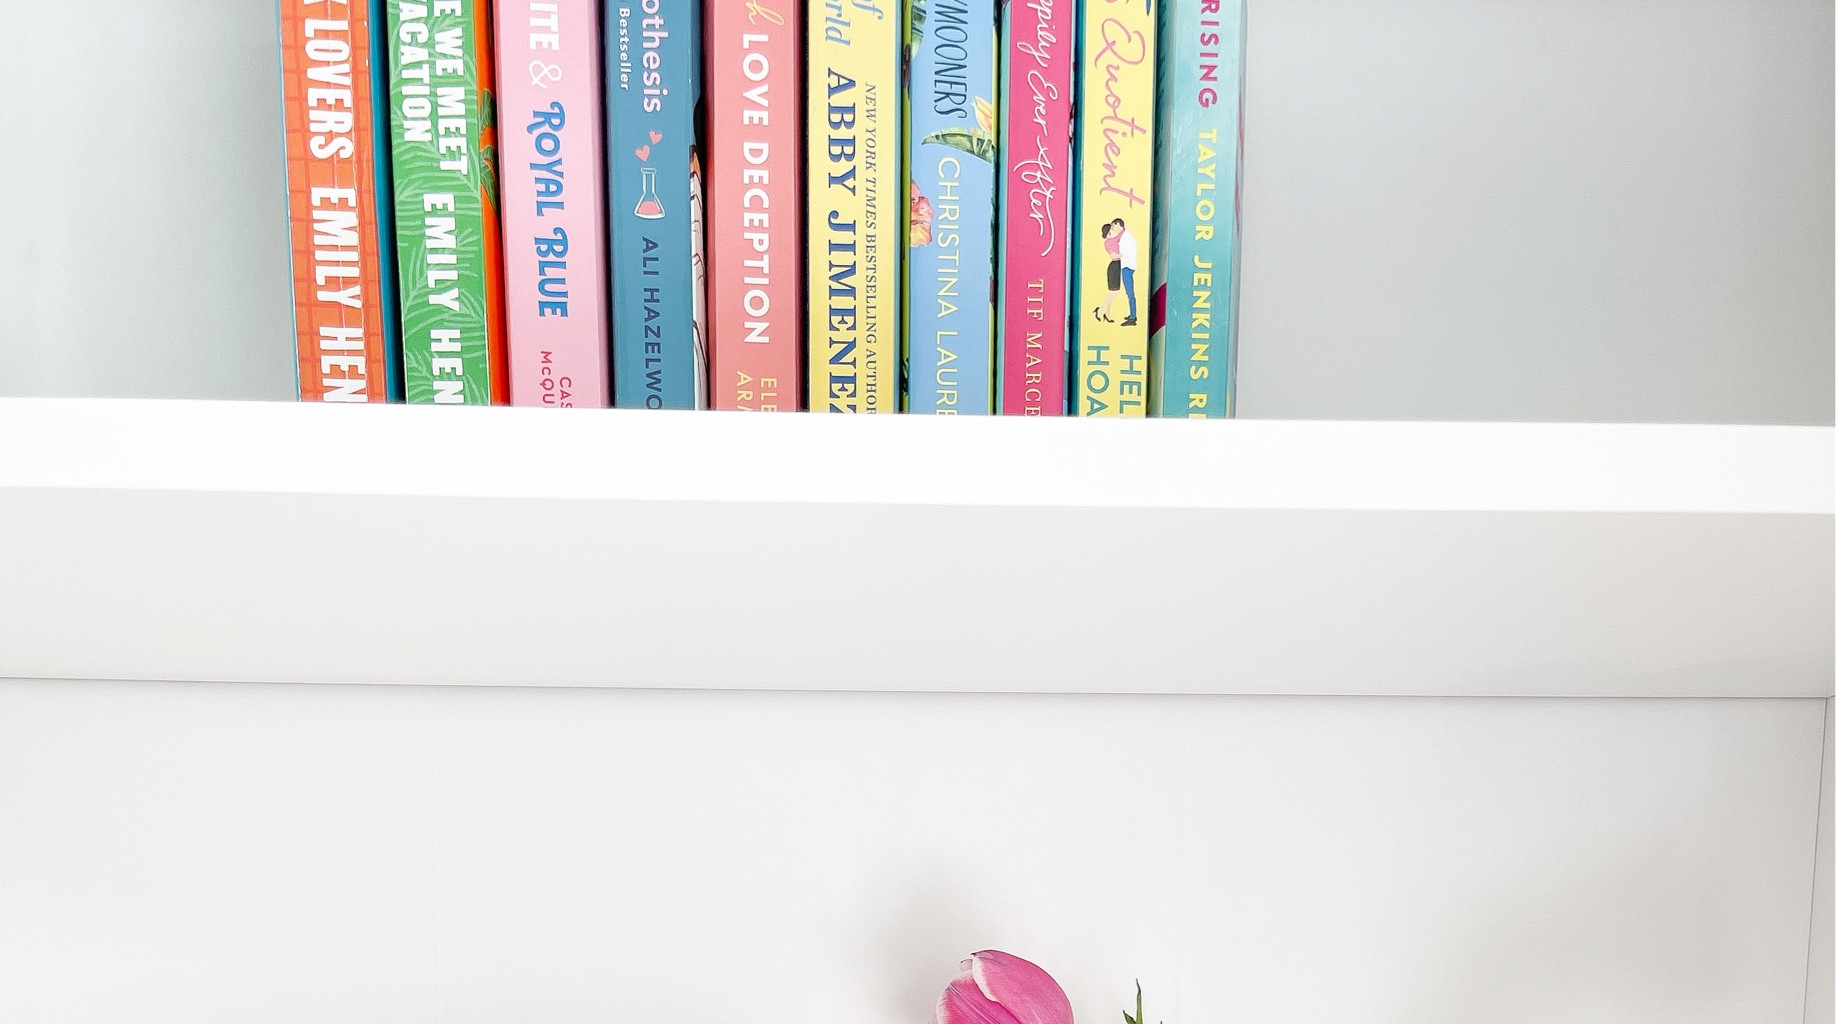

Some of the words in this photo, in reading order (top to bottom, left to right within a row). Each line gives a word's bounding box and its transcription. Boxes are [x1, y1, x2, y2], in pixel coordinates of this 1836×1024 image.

[398, 0, 433, 142] ACATION
[433, 27, 464, 76] WE
[528, 60, 562, 90] &
[618, 8, 632, 91] Bestseller
[825, 0, 851, 46] rld
[1198, 0, 1220, 108] RISING
[304, 18, 353, 160] LOVERS
[436, 86, 469, 176] MEET
[742, 33, 769, 128] LOVE
[827, 67, 856, 196] ABBY
[865, 82, 877, 121] NEW
[1027, 70, 1059, 137] Ever
[1094, 17, 1147, 209] Quotient
[865, 127, 877, 174] YORK
[865, 177, 877, 229] TIMES
[1012, 136, 1059, 257] After
[1195, 129, 1217, 241] TAYLOR
[311, 186, 362, 309] EMILY
[423, 193, 460, 311] EMILY
[642, 236, 660, 276] ALI
[743, 141, 771, 344] DECEPTION
[865, 233, 877, 344] BESTSELLING
[937, 156, 961, 319] CHRISTINA
[1027, 278, 1044, 322] TIF
[1189, 255, 1215, 381] JENKINS
